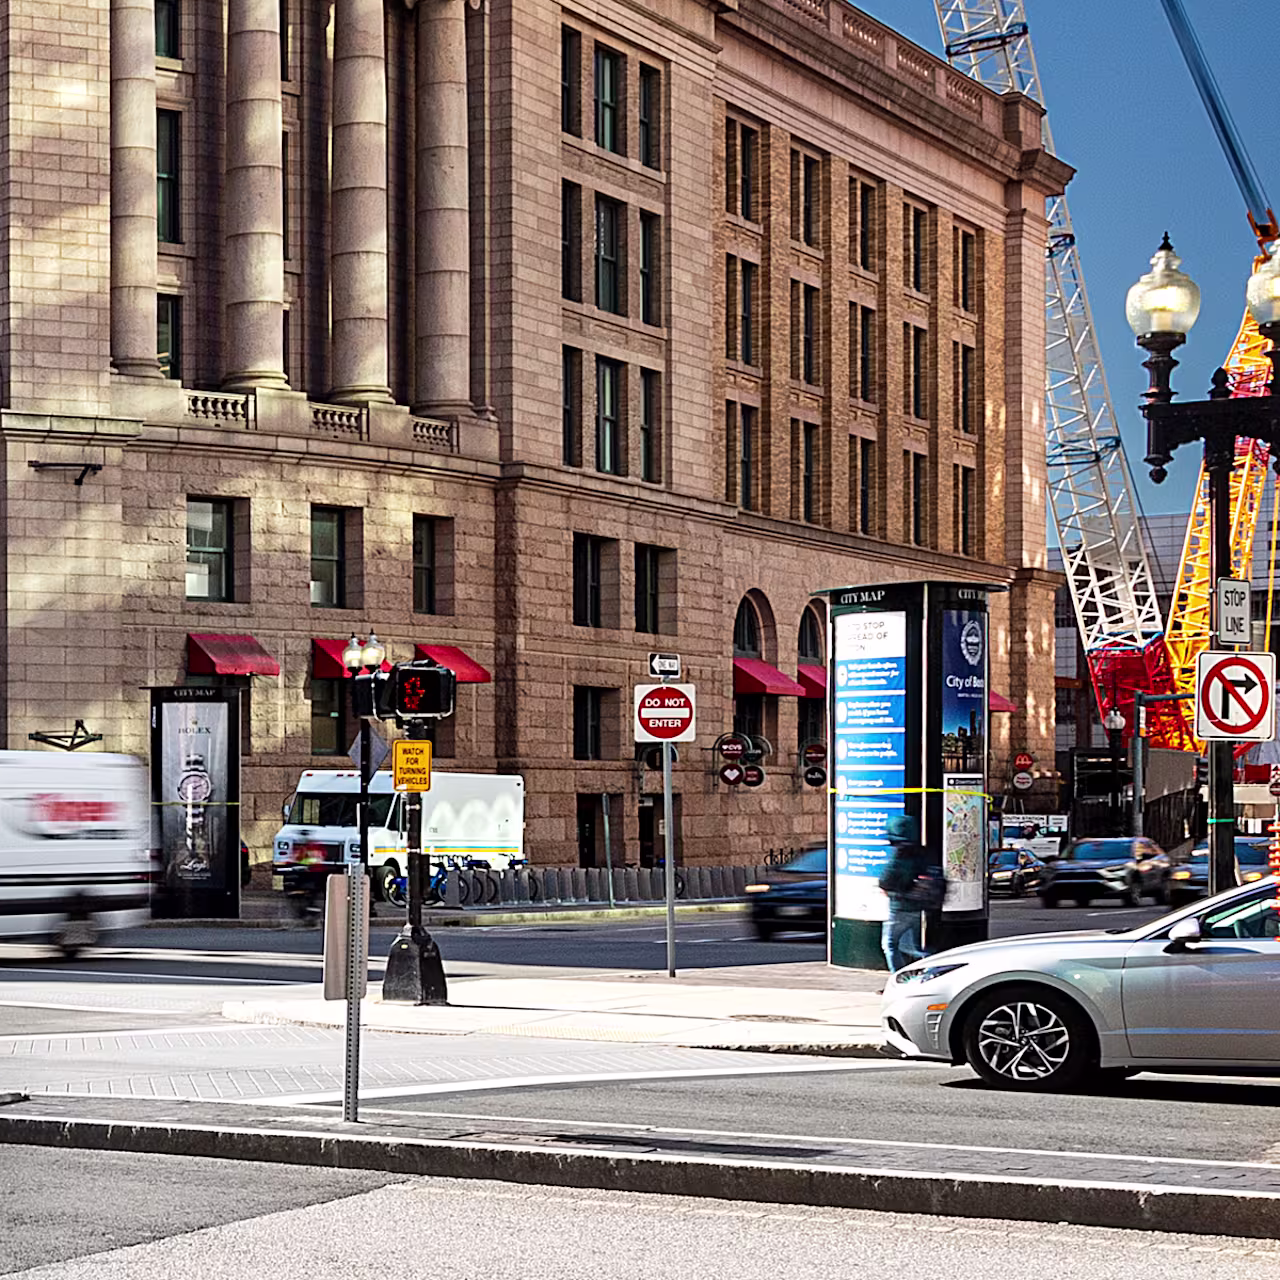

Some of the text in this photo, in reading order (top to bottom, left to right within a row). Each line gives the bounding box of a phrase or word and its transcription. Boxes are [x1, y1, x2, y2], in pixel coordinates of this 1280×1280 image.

[840, 590, 886, 604] CITY MAP
[958, 588, 977, 600] CITY
[1224, 589, 1246, 607] STOP
[863, 622, 885, 630] STOP
[1225, 616, 1245, 633] LINE
[876, 631, 889, 640] OF
[946, 675, 964, 690] City
[965, 675, 973, 687] of
[173, 689, 216, 697] CITY MAP
[644, 698, 686, 707] DO NOT
[649, 719, 682, 728] ENTER
[402, 747, 424, 755] WATCH
[406, 757, 419, 765] FOR
[399, 767, 426, 775] TURNING
[398, 777, 427, 785] VEHICLES
